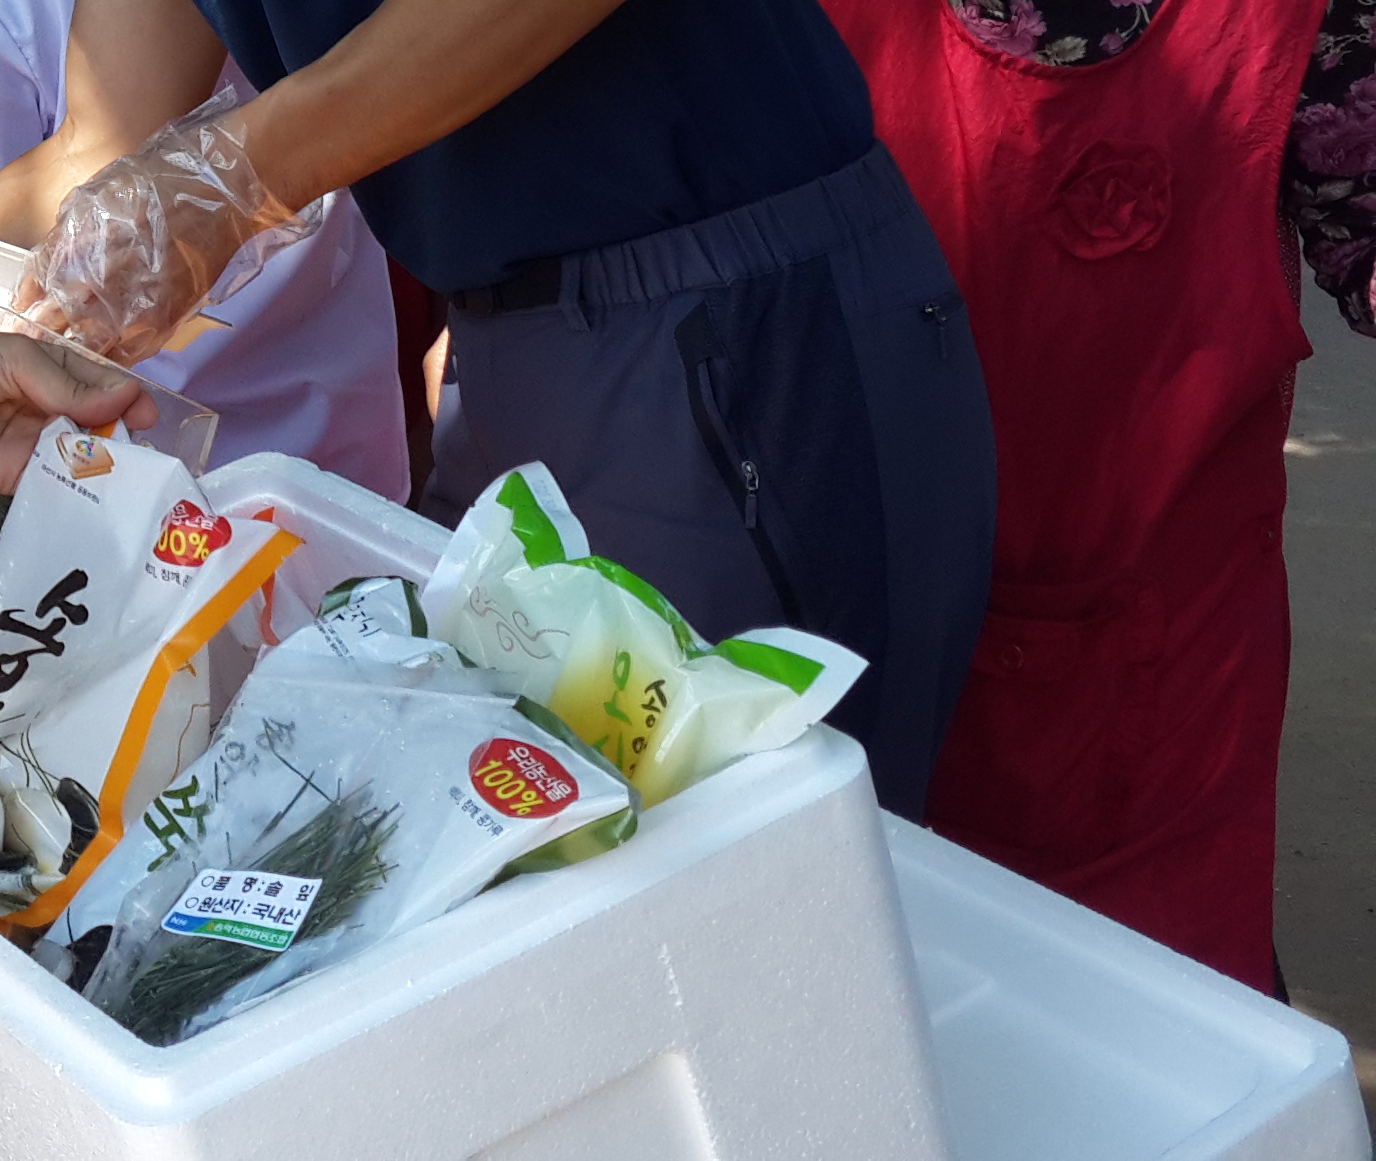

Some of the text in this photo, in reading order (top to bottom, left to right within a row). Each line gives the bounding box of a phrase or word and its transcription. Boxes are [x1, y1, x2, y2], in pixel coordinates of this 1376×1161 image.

[474, 759, 544, 816] 100%
[505, 746, 572, 803] 우리농산물
[212, 876, 231, 891] 품
[251, 902, 302, 926] 국내산
